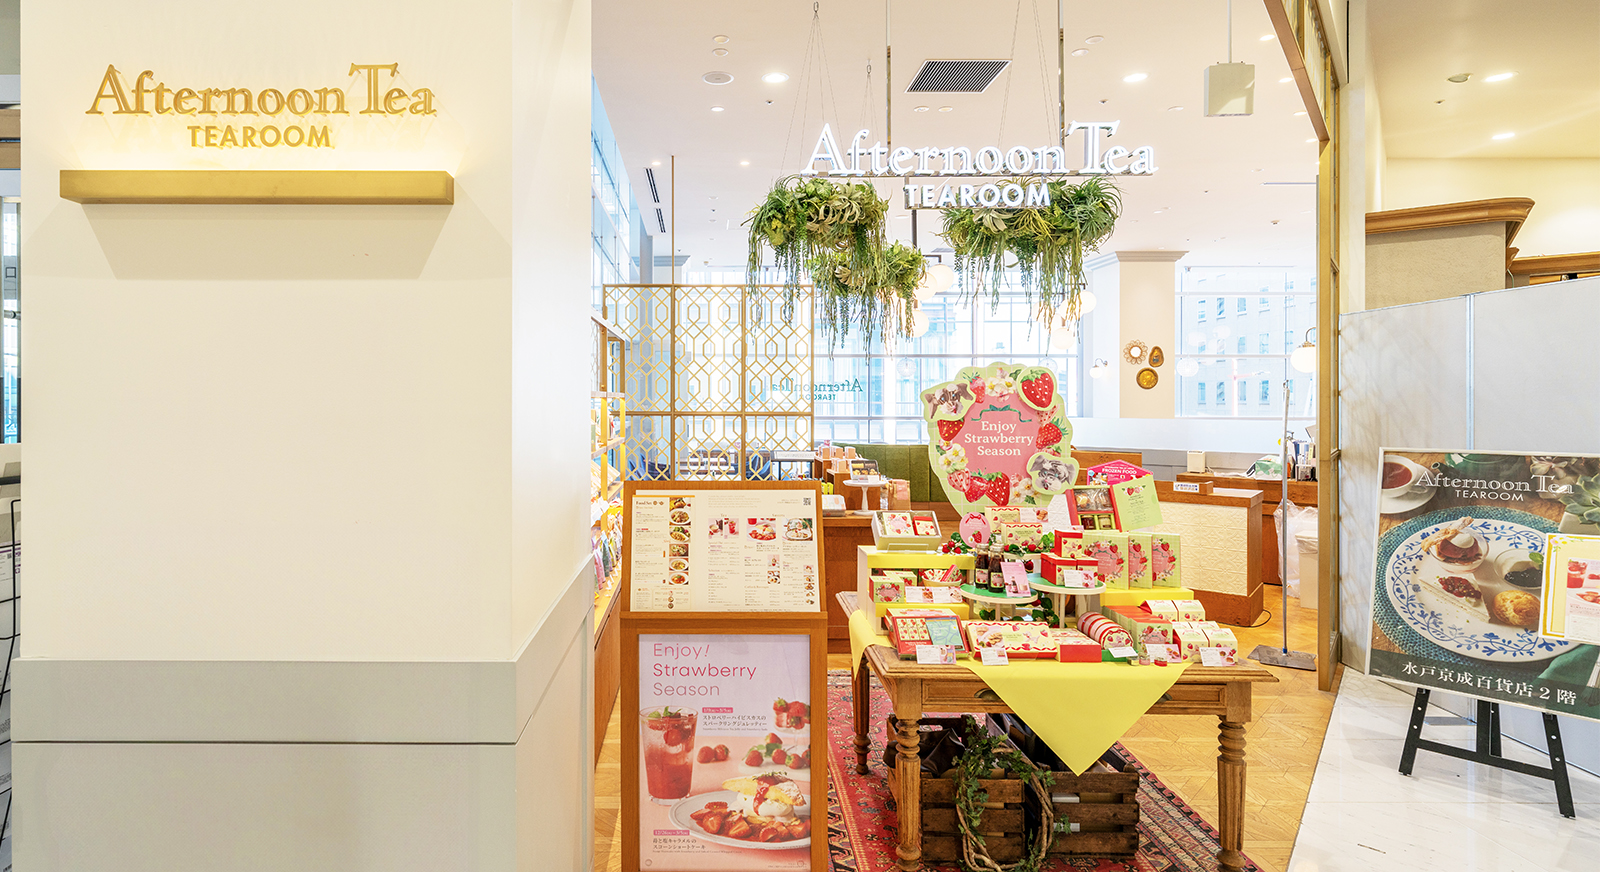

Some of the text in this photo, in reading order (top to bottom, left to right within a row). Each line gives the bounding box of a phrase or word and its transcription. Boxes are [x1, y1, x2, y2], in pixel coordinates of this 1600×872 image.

[85, 62, 437, 115] Afternoon Tea
[187, 125, 333, 148] TEAROOM
[800, 120, 1159, 176] Afternoon Tea
[905, 183, 1050, 208] TEAROOM
[981, 421, 1017, 434] Enjoy
[964, 433, 1034, 446] Strawberry
[977, 446, 1021, 456] Season
[1415, 470, 1574, 494] Afternoon Tea
[1455, 489, 1524, 501] TEAROOM
[653, 643, 710, 660] Enjoy!
[653, 663, 757, 680] Strawberry
[653, 682, 720, 696] Season
